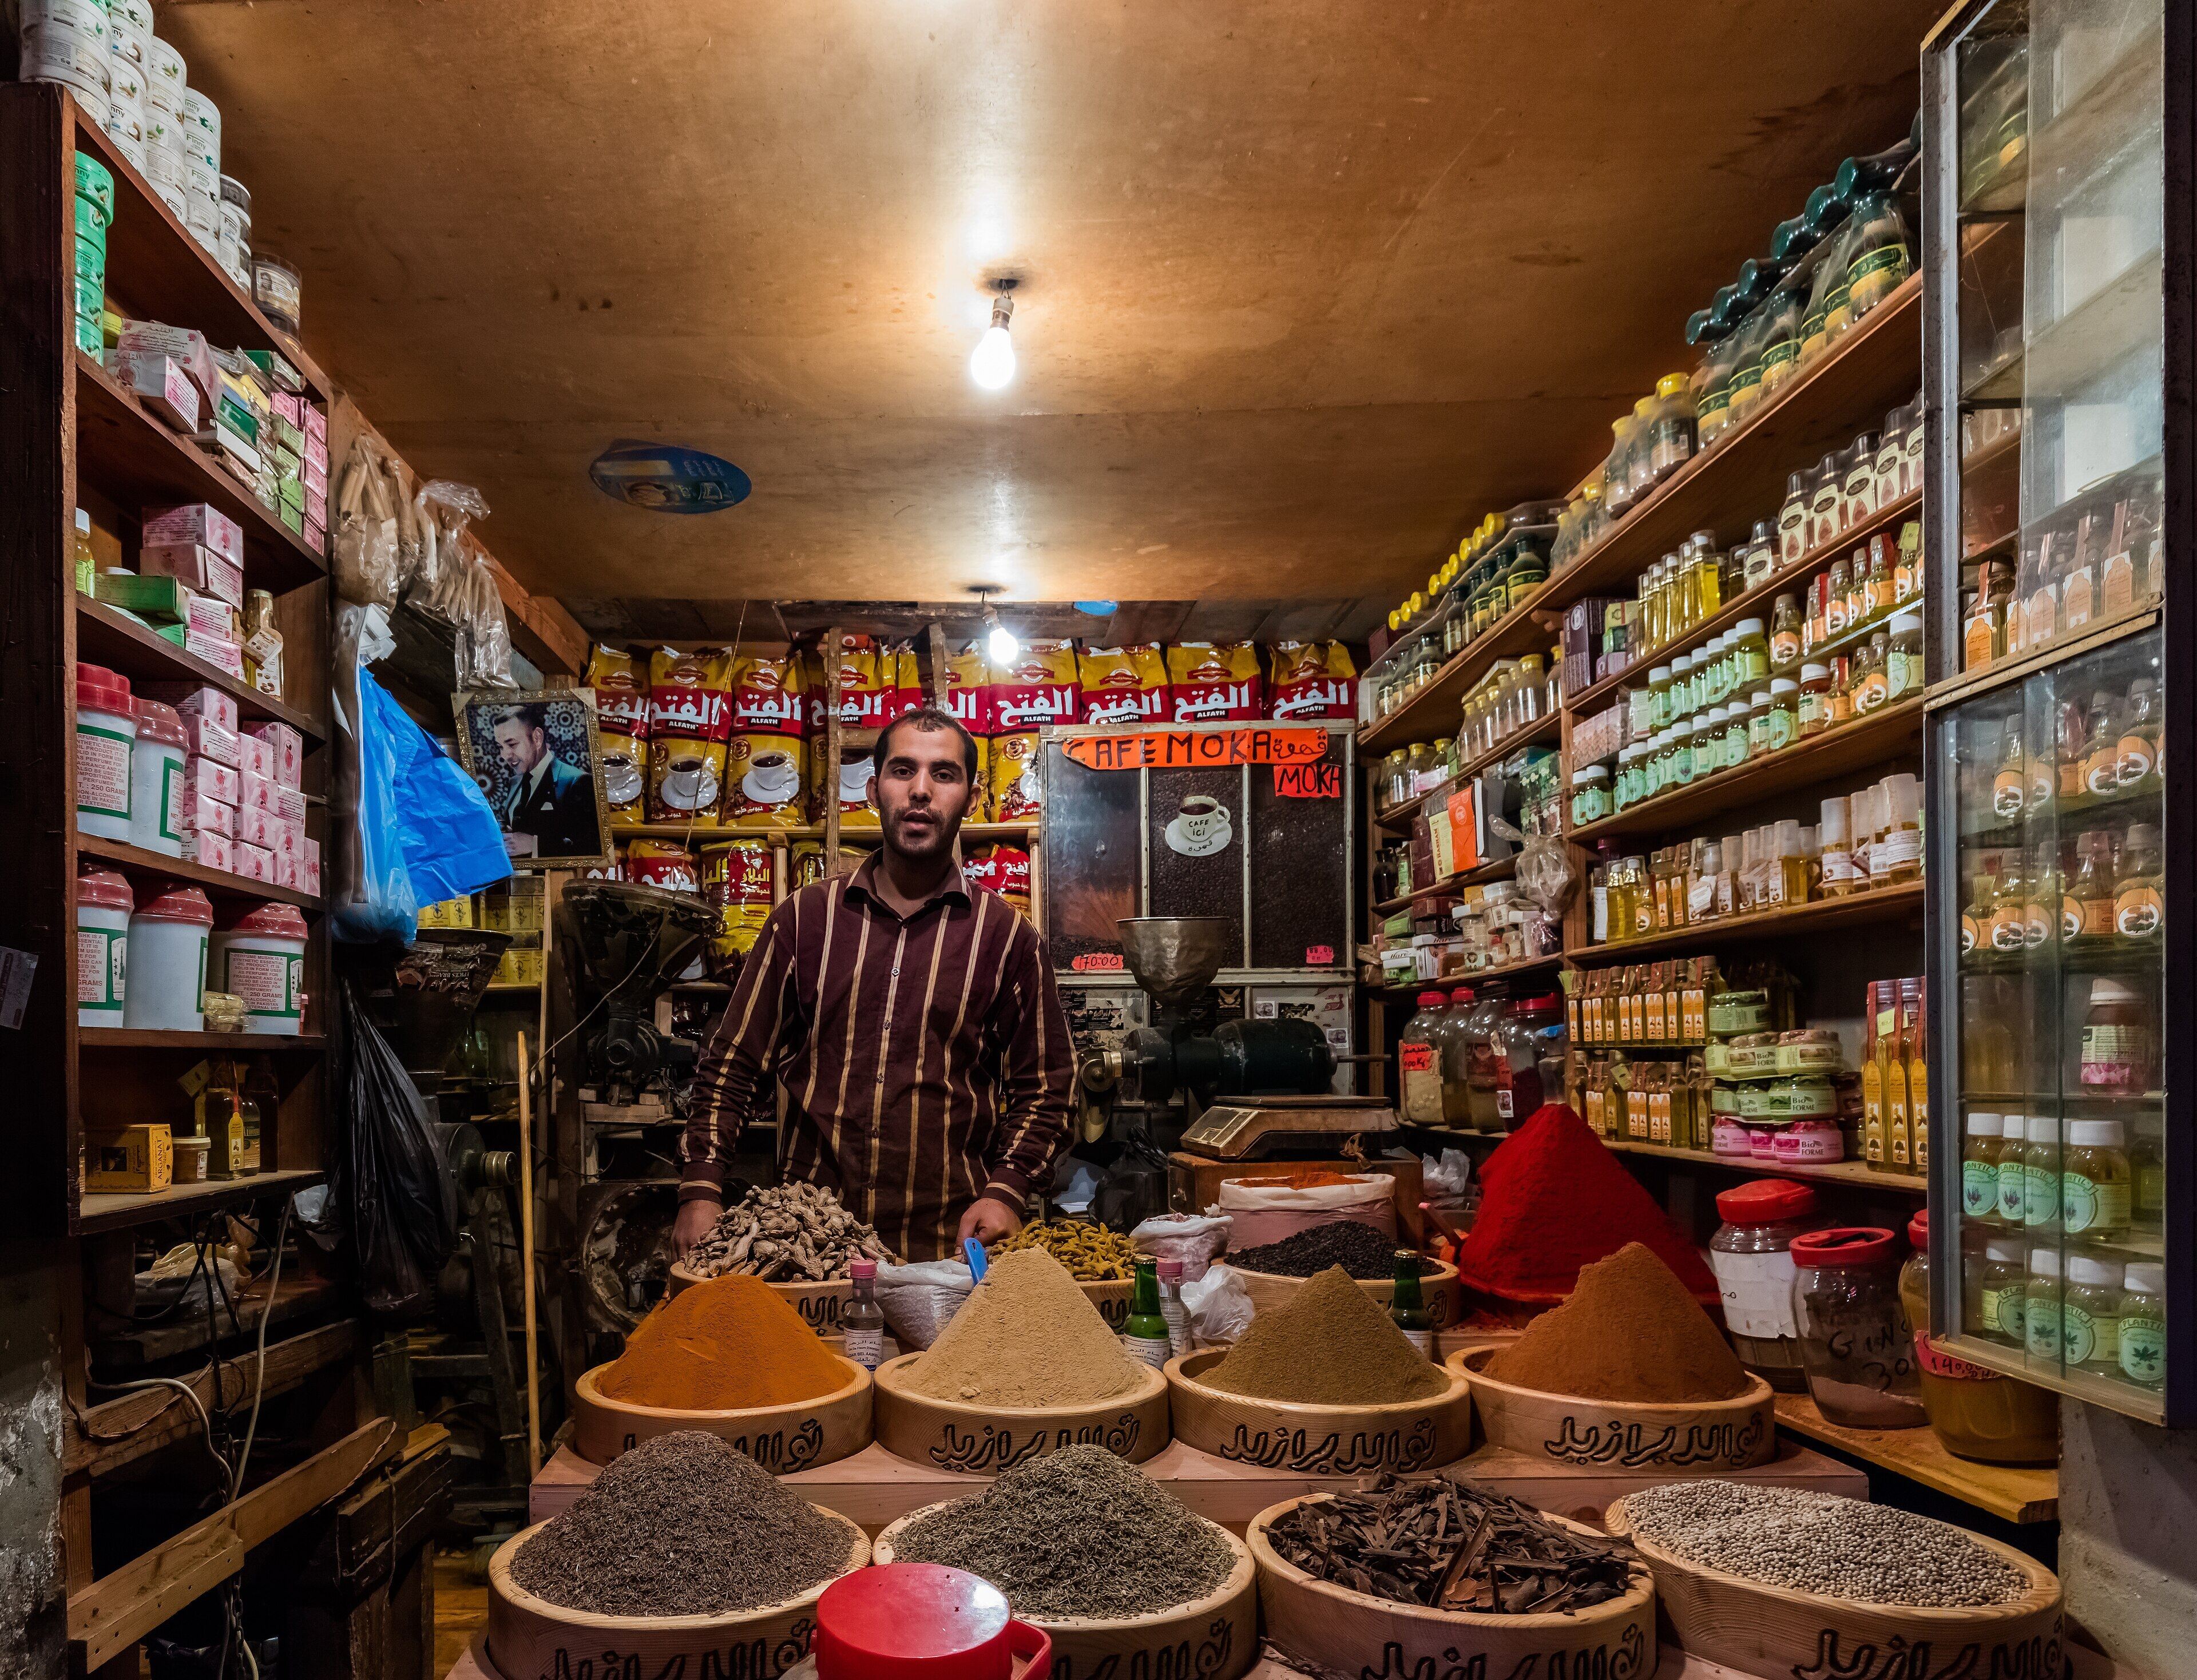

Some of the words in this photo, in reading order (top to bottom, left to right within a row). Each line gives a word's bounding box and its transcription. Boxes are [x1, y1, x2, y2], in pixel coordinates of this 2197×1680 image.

[997, 686, 1073, 726] الفتح
[1175, 681, 1249, 722] الفتح
[1273, 679, 1348, 720] الفتح
[597, 695, 651, 722] الفت
[650, 692, 721, 730] الفتح
[734, 691, 801, 727] الفتح
[1089, 688, 1161, 725] الفتح
[1296, 705, 1324, 714] ALFATH
[1112, 714, 1139, 723] ALFATH
[1197, 710, 1225, 718] ALFATH
[668, 721, 696, 729] ALFATH
[751, 717, 778, 725] ALFATH
[77, 771, 114, 781] OMPOSITIONS
[1277, 765, 1340, 793] MOKA
[1188, 819, 1209, 828] CAFE
[1964, 1161, 1990, 1171] LANTIL
[2122, 1318, 2164, 1331] PLANTI
